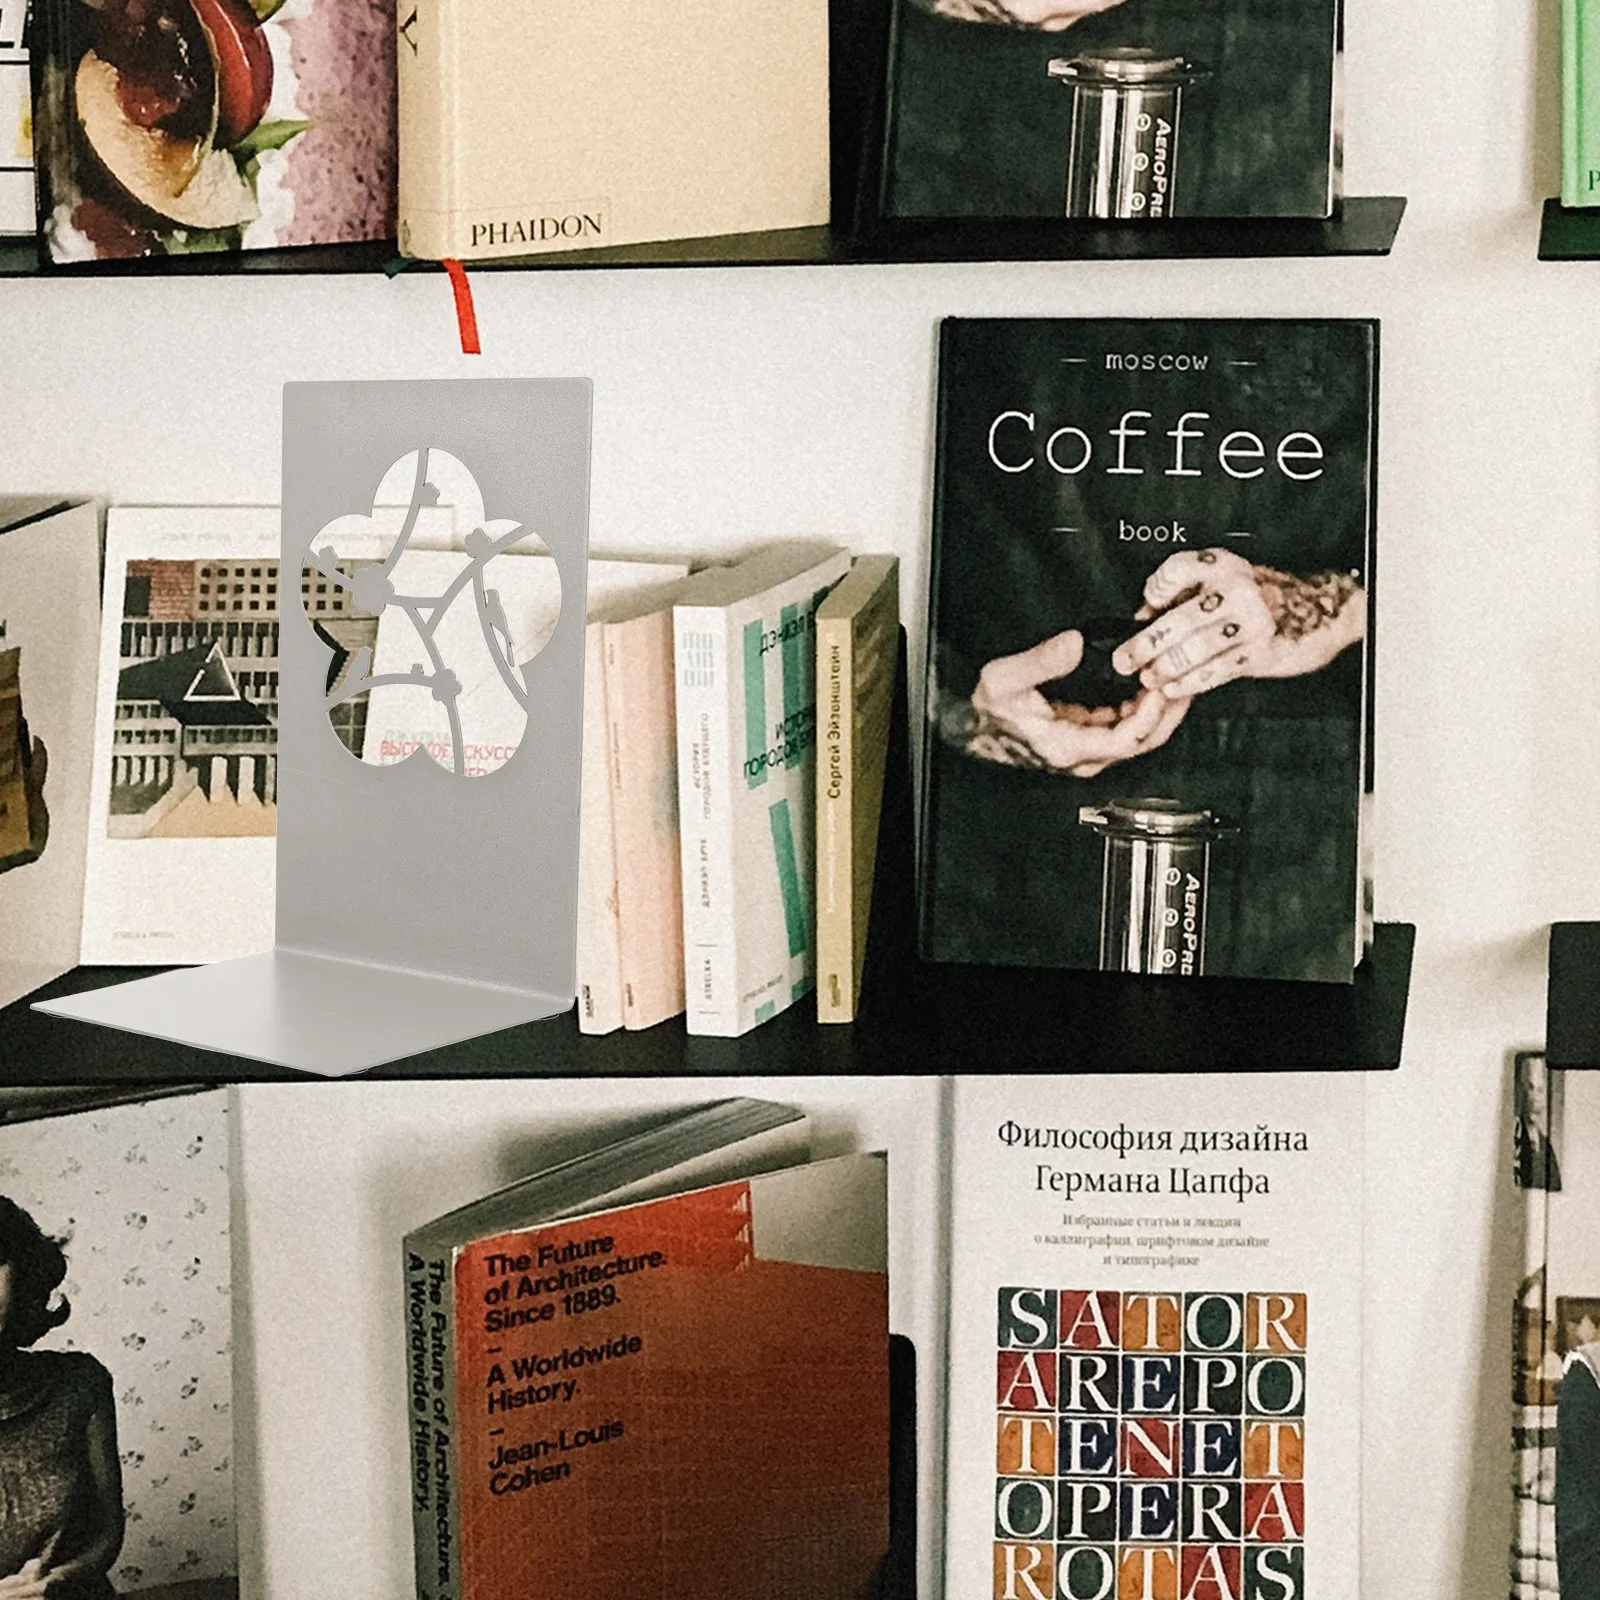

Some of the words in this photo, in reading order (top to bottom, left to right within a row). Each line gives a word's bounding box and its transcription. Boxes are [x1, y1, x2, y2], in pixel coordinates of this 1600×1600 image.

[470, 213, 604, 248] PHAIDON
[1105, 352, 1209, 372] moscow
[988, 410, 1325, 480] Coffee
[1118, 519, 1188, 544] book
[997, 1120, 1171, 1159] Философия
[1180, 1124, 1309, 1155] дизайна
[1035, 1164, 1160, 1200] Германа
[1168, 1166, 1270, 1203] Цапфа
[408, 1252, 425, 1272] A
[484, 1254, 531, 1278] The
[538, 1234, 615, 1268] Future
[484, 1283, 512, 1306] of
[516, 1247, 667, 1300] Architecture.
[428, 1259, 446, 1305] The
[485, 1302, 555, 1334] Since
[563, 1284, 622, 1315] 1889.
[1008, 1288, 1298, 1350] SATOR
[408, 1279, 429, 1412] Worldwide
[427, 1309, 449, 1391] Future
[486, 1364, 507, 1387] A
[513, 1334, 643, 1378] Worldwide
[488, 1377, 581, 1415] History.
[1000, 1353, 1303, 1414] AREPO
[430, 1399, 448, 1427] of
[416, 1418, 431, 1513] History.
[489, 1418, 625, 1471] Jean-Louis
[1002, 1419, 1301, 1478] TENET
[489, 1461, 571, 1498] Cohen
[999, 1480, 1299, 1541] OPERA
[1001, 1544, 1298, 1600] ROTAS
